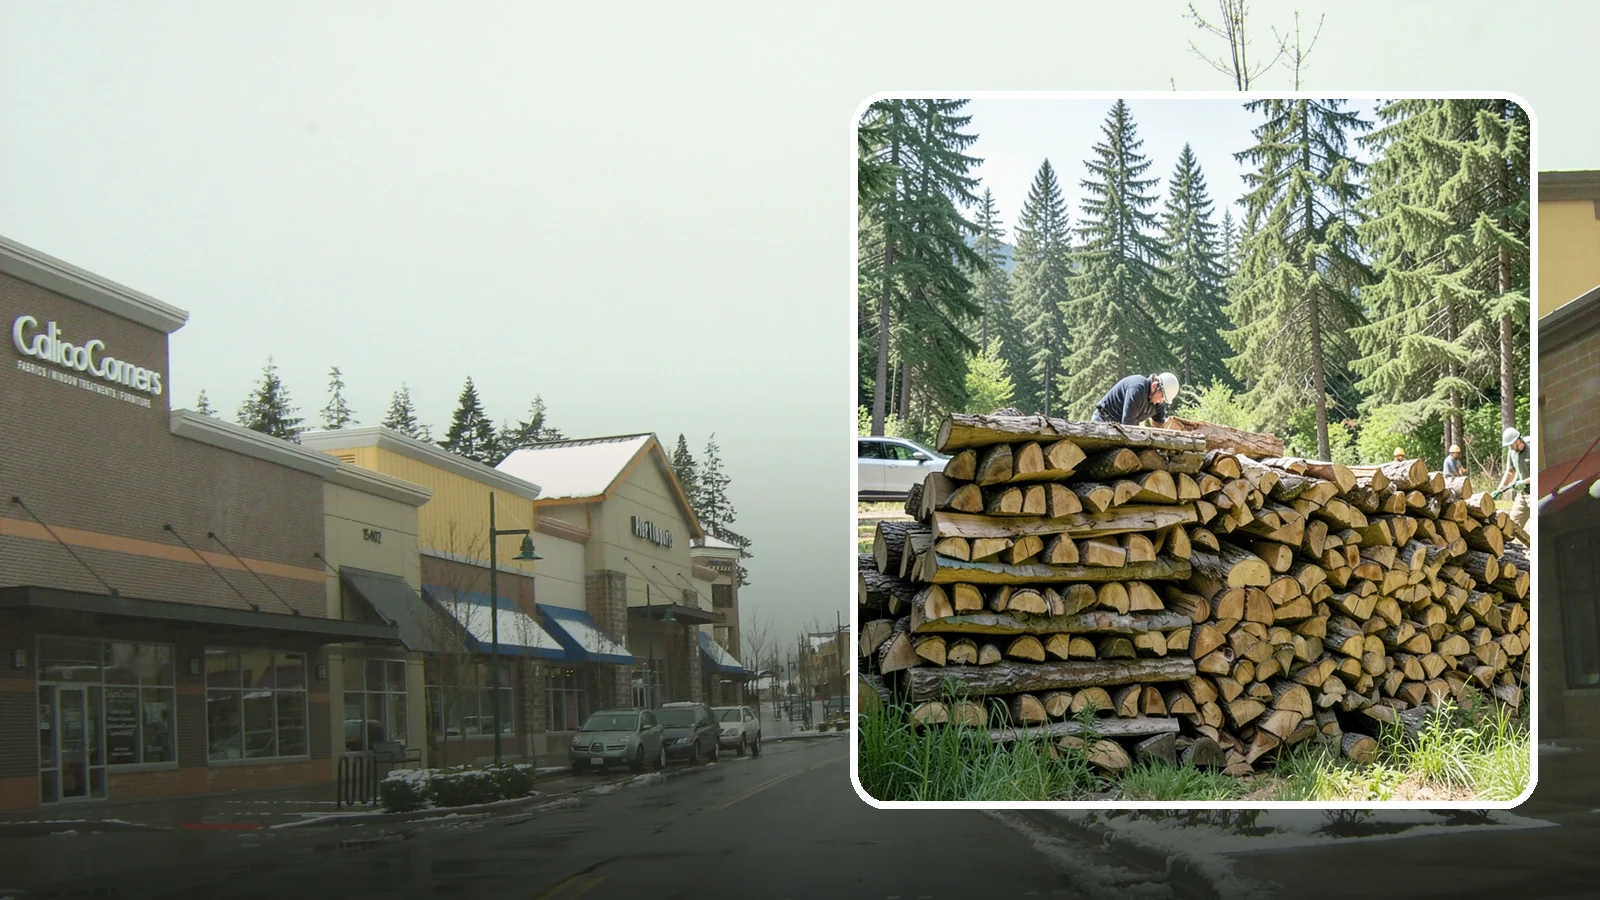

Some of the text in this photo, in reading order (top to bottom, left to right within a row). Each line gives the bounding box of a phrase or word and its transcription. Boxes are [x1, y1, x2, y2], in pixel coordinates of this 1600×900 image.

[17, 360, 47, 377] FABRICS
[51, 370, 78, 386] WINDOW
[78, 378, 116, 398] TREATMENTS
[120, 391, 151, 408] FURNITURE
